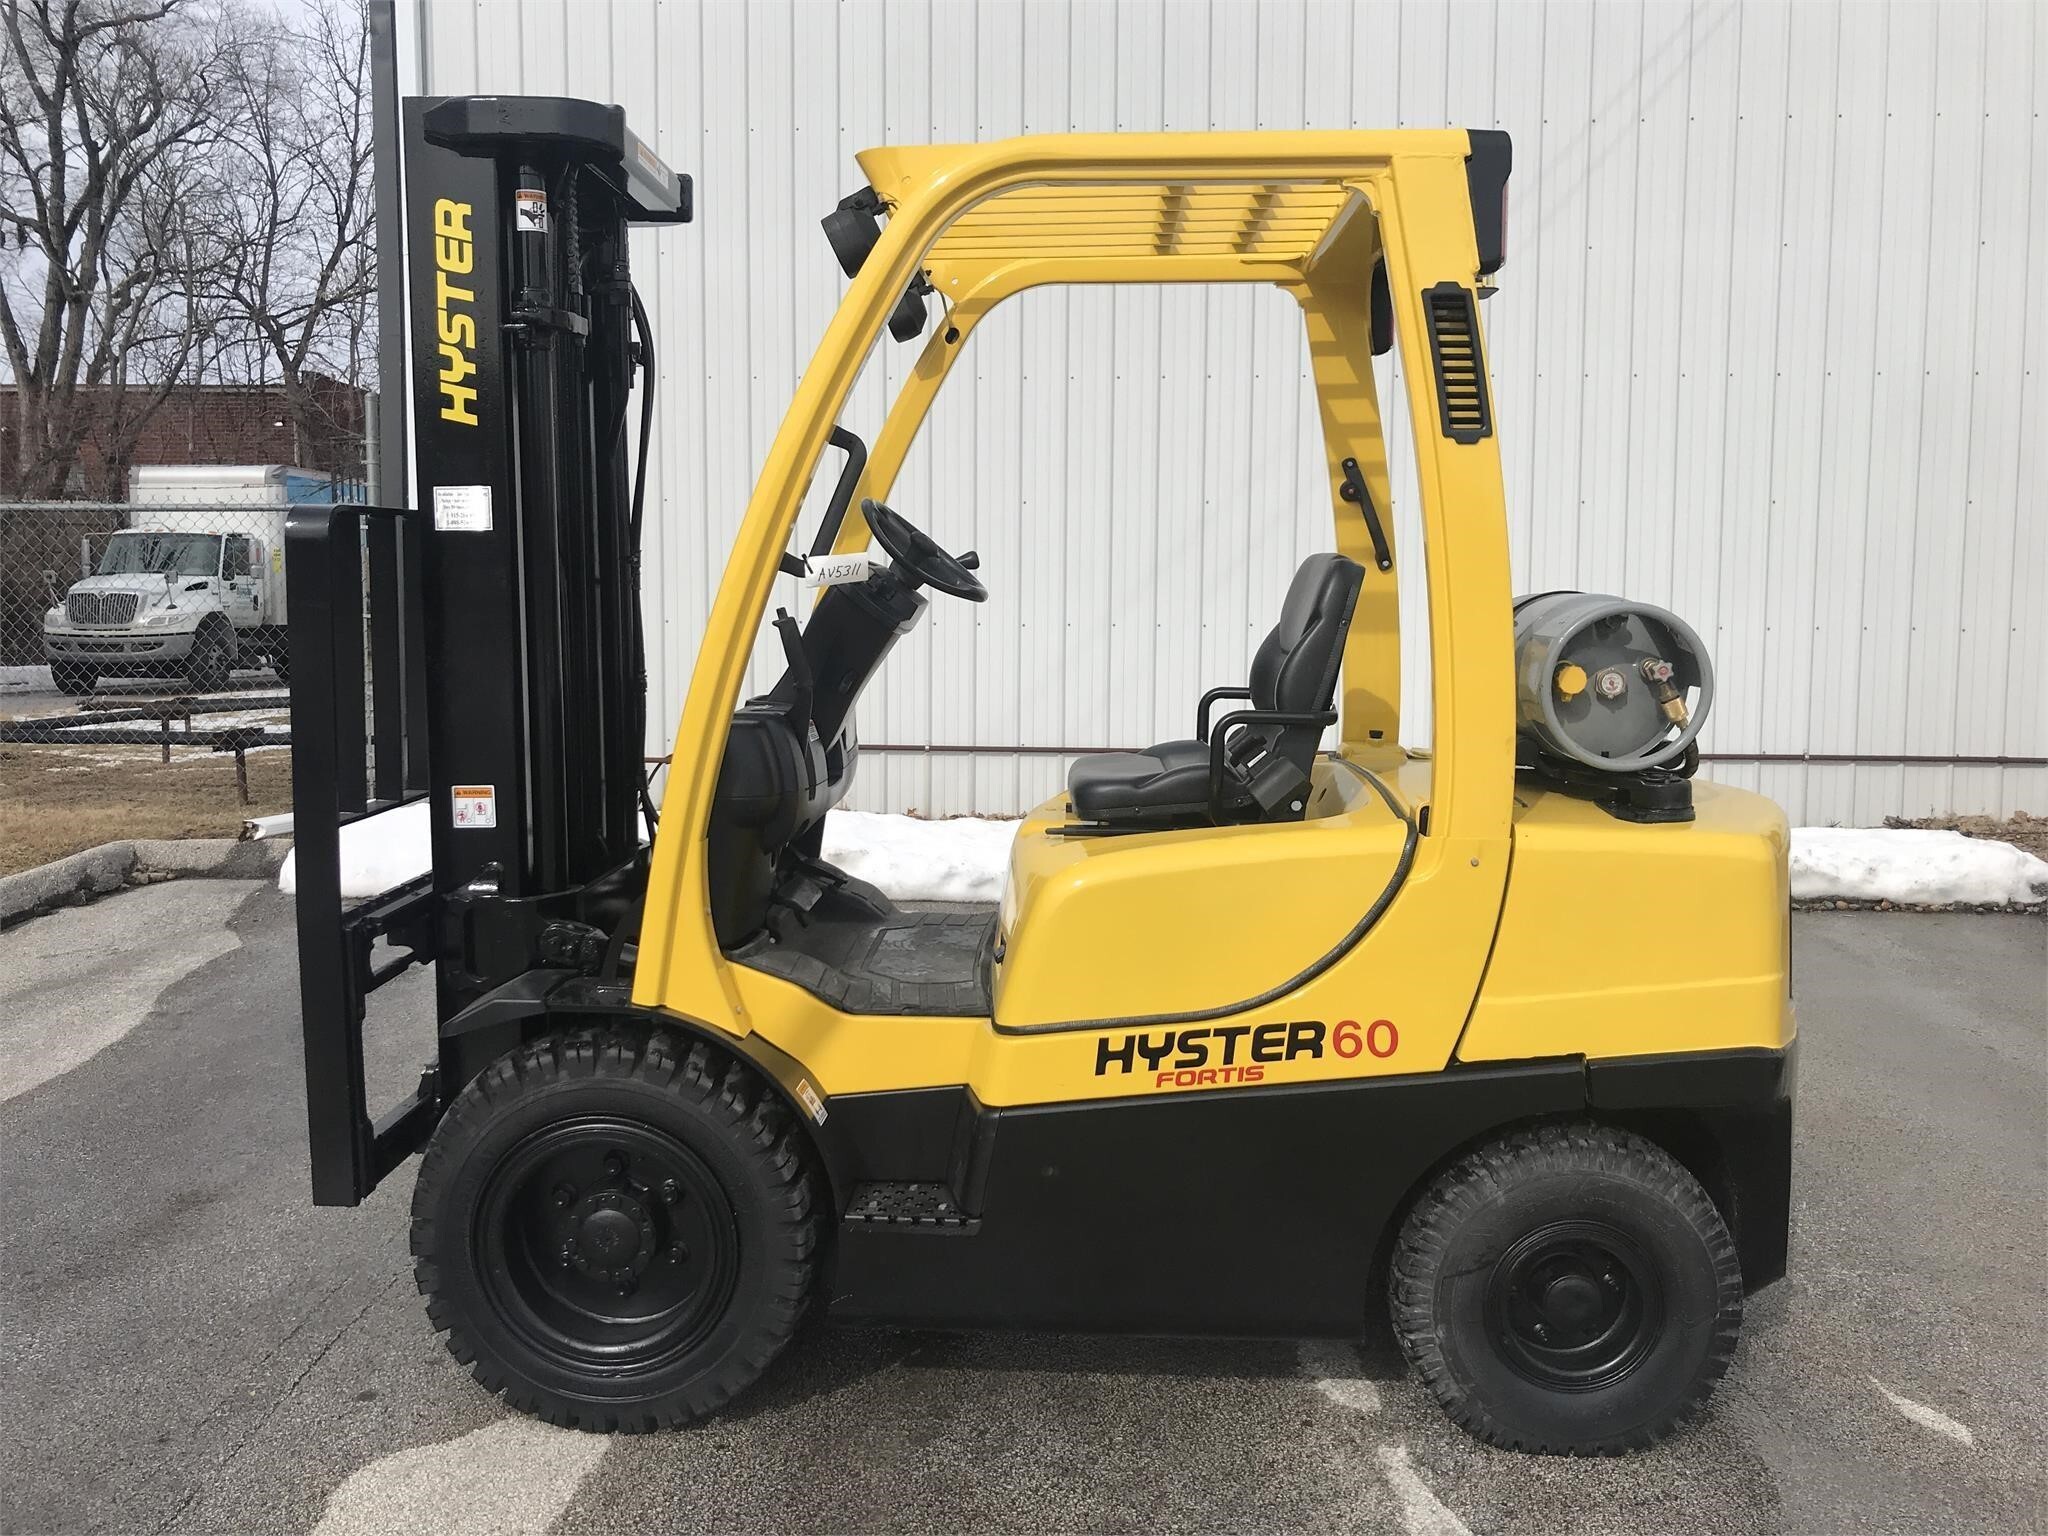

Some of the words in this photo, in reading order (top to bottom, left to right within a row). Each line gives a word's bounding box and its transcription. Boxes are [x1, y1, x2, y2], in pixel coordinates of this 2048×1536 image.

[435, 199, 478, 426] HYSTER
[818, 563, 861, 581] AV5311
[1095, 1021, 1326, 1076] HYSTER
[1332, 1019, 1399, 1058] 60
[1156, 1065, 1265, 1088] FORTIS
